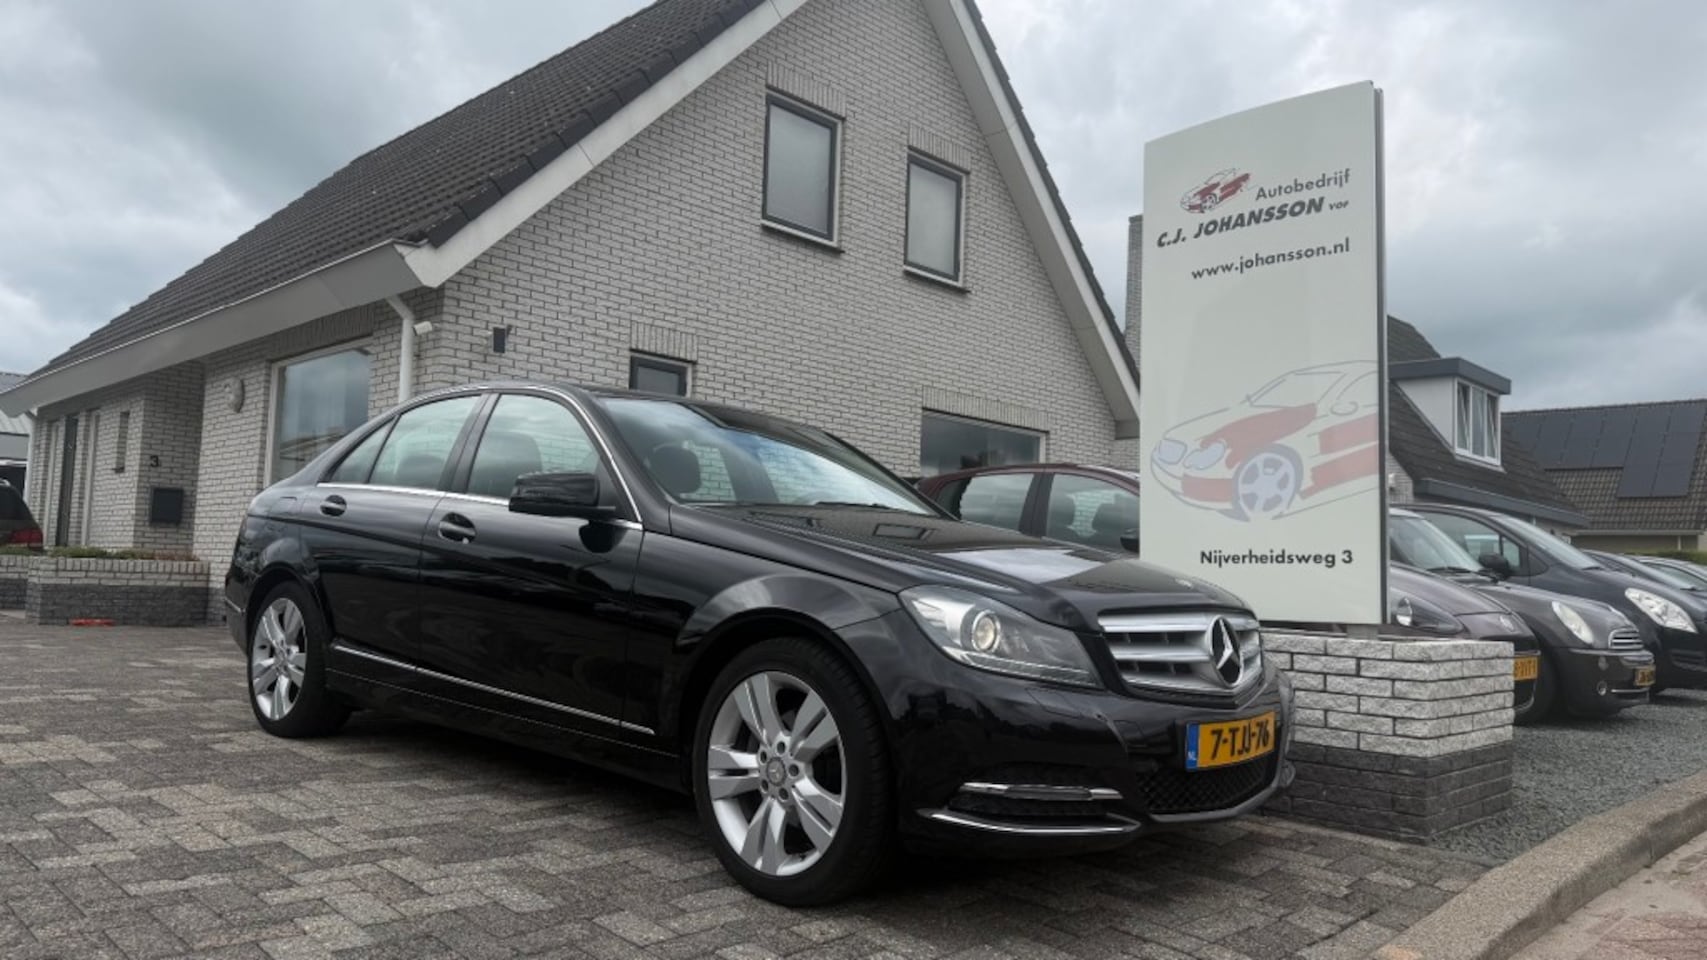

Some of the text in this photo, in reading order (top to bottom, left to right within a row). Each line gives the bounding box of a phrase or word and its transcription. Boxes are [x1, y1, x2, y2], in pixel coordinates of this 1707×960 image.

[1255, 168, 1351, 201] Autobedrijf
[1157, 228, 1187, 248] C.J.
[1194, 196, 1325, 239] JOHANSSON
[1191, 237, 1350, 280] www.johansson.nl
[150, 455, 160, 468] 3
[1200, 549, 1354, 568] Nijverheidsweg 3
